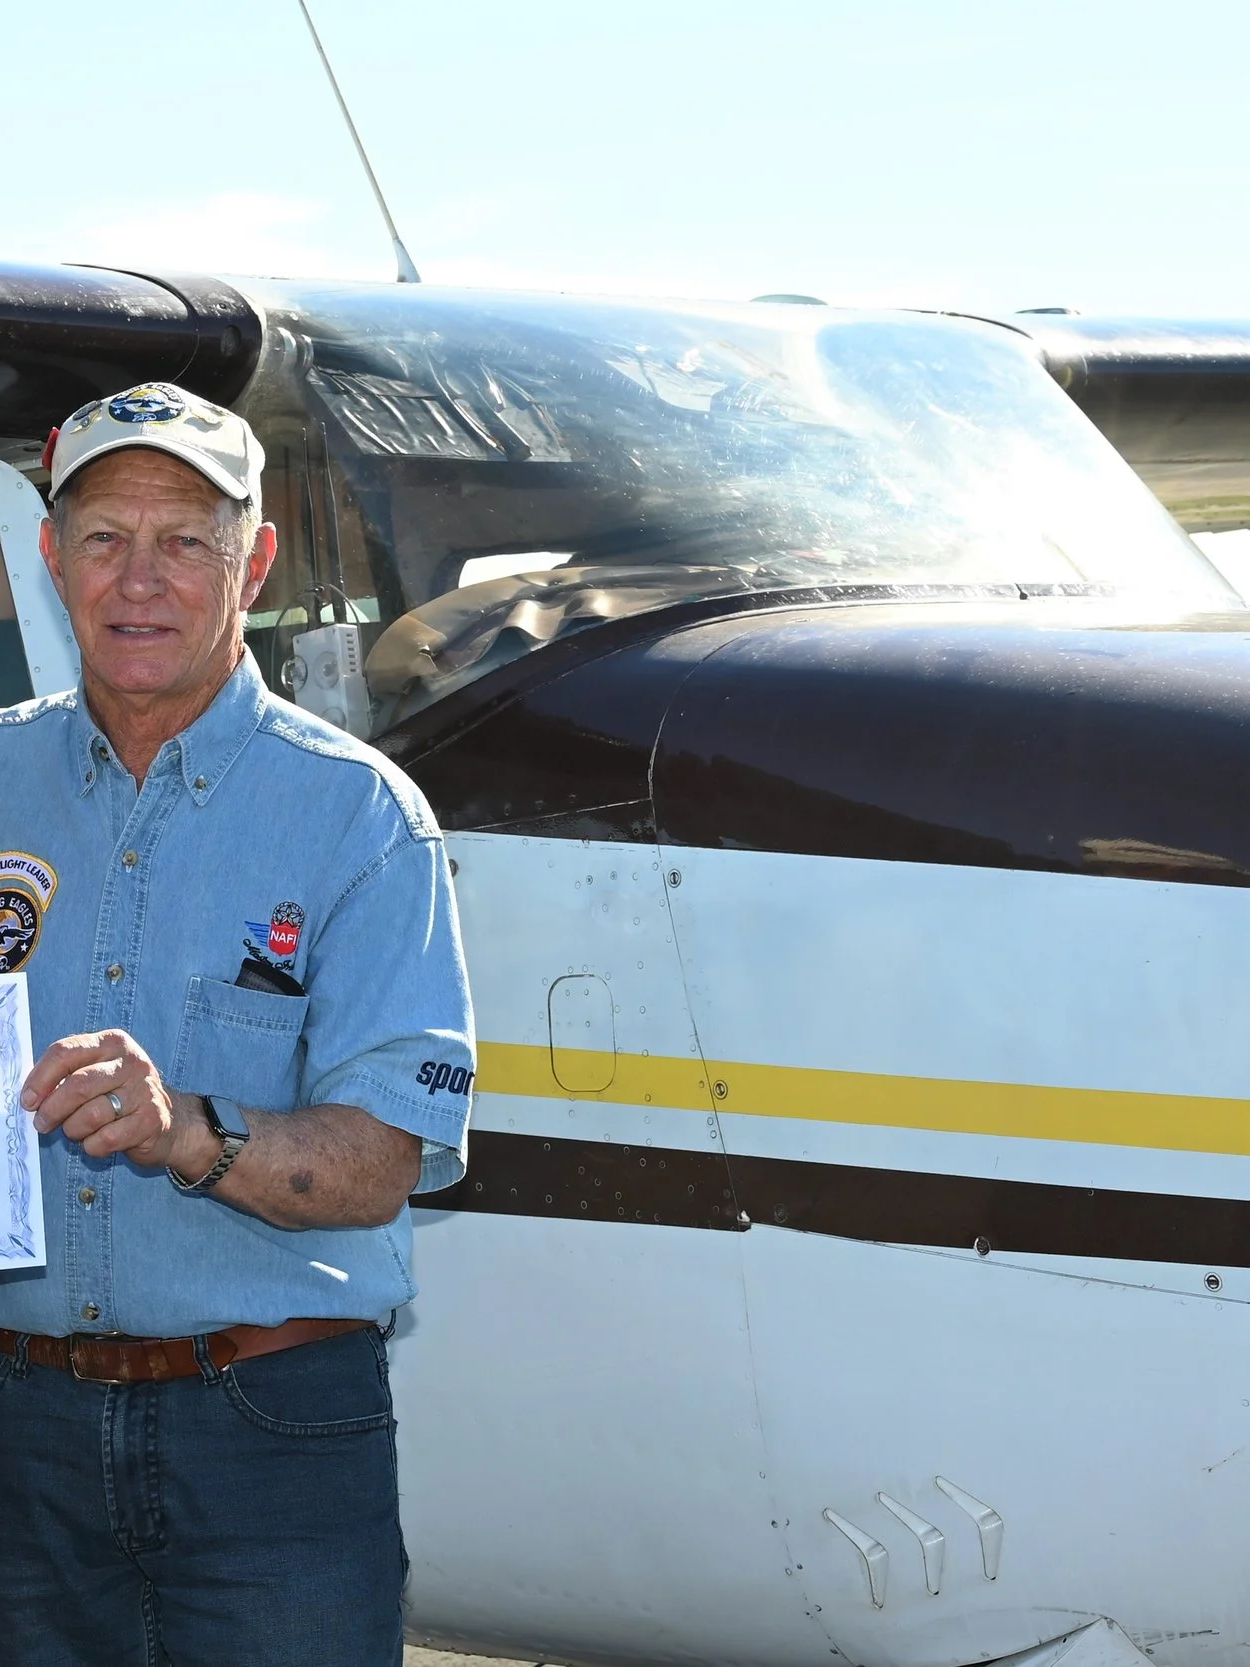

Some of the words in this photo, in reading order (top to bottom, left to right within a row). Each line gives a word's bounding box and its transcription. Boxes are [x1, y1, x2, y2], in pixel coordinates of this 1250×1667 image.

[26, 863, 51, 891] LEADER
[9, 897, 33, 926] EAGLES
[270, 930, 297, 945] NAFI
